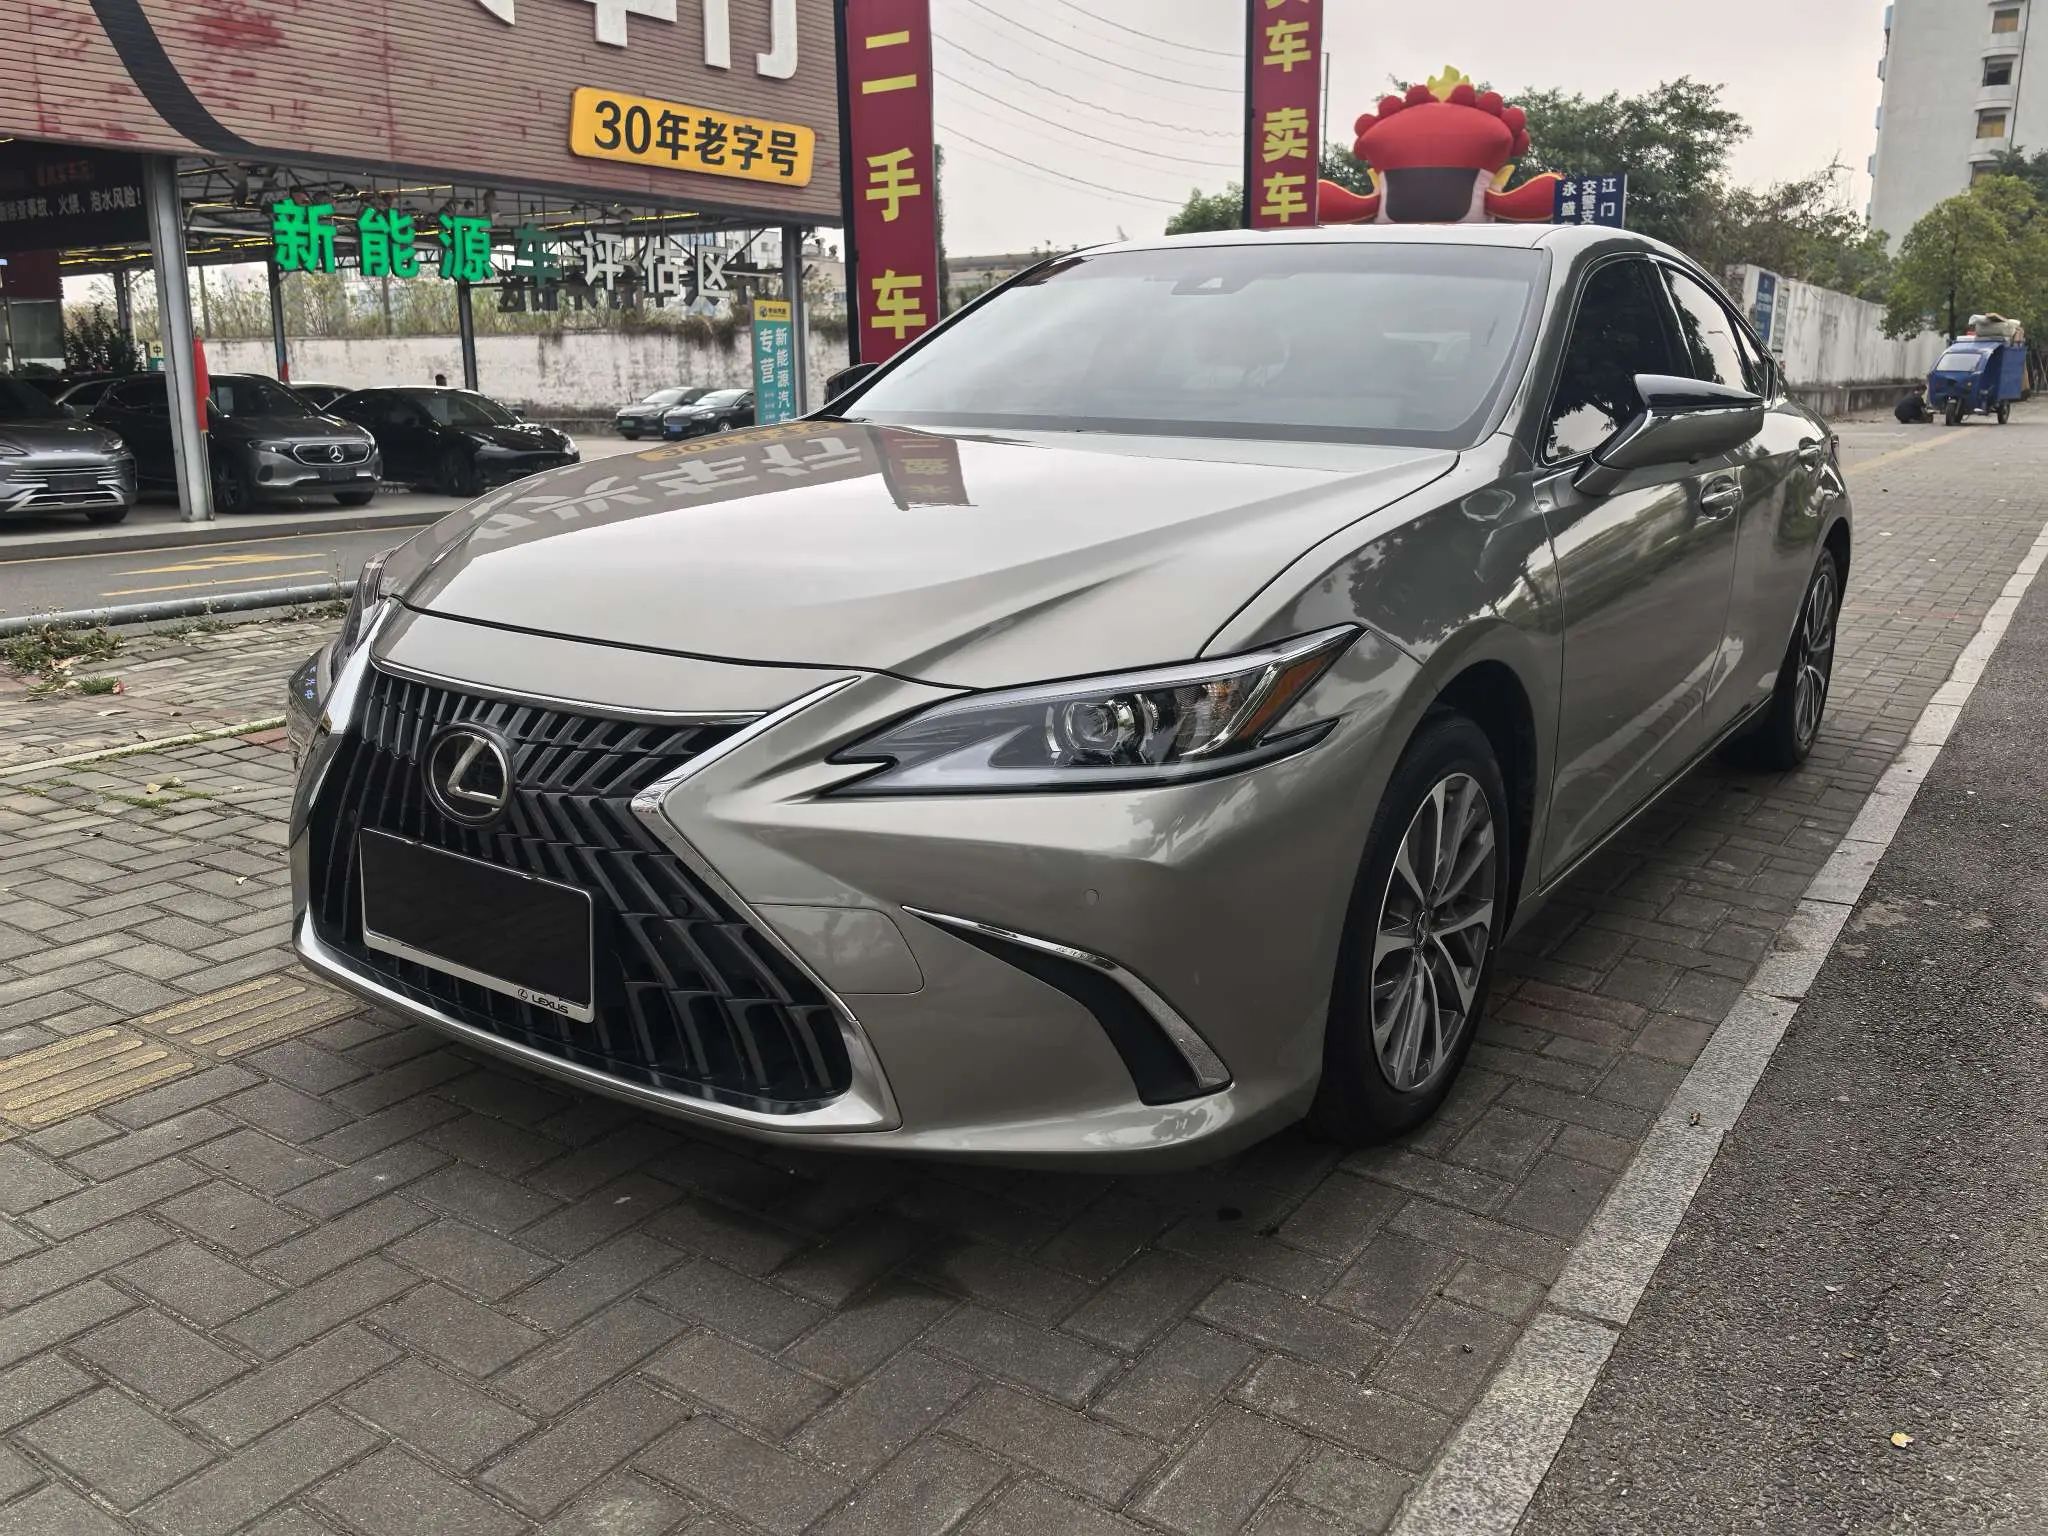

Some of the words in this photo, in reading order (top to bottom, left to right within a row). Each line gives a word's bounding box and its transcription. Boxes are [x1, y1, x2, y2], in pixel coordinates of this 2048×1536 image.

[594, 100, 799, 177] 30年老字号
[862, 30, 927, 340] 二手车
[1561, 182, 1577, 225] 永盛
[1601, 178, 1617, 217] 江门
[271, 198, 732, 298] 新能源车评估区
[760, 327, 775, 385] 专营
[531, 994, 569, 1014] LEXUS
